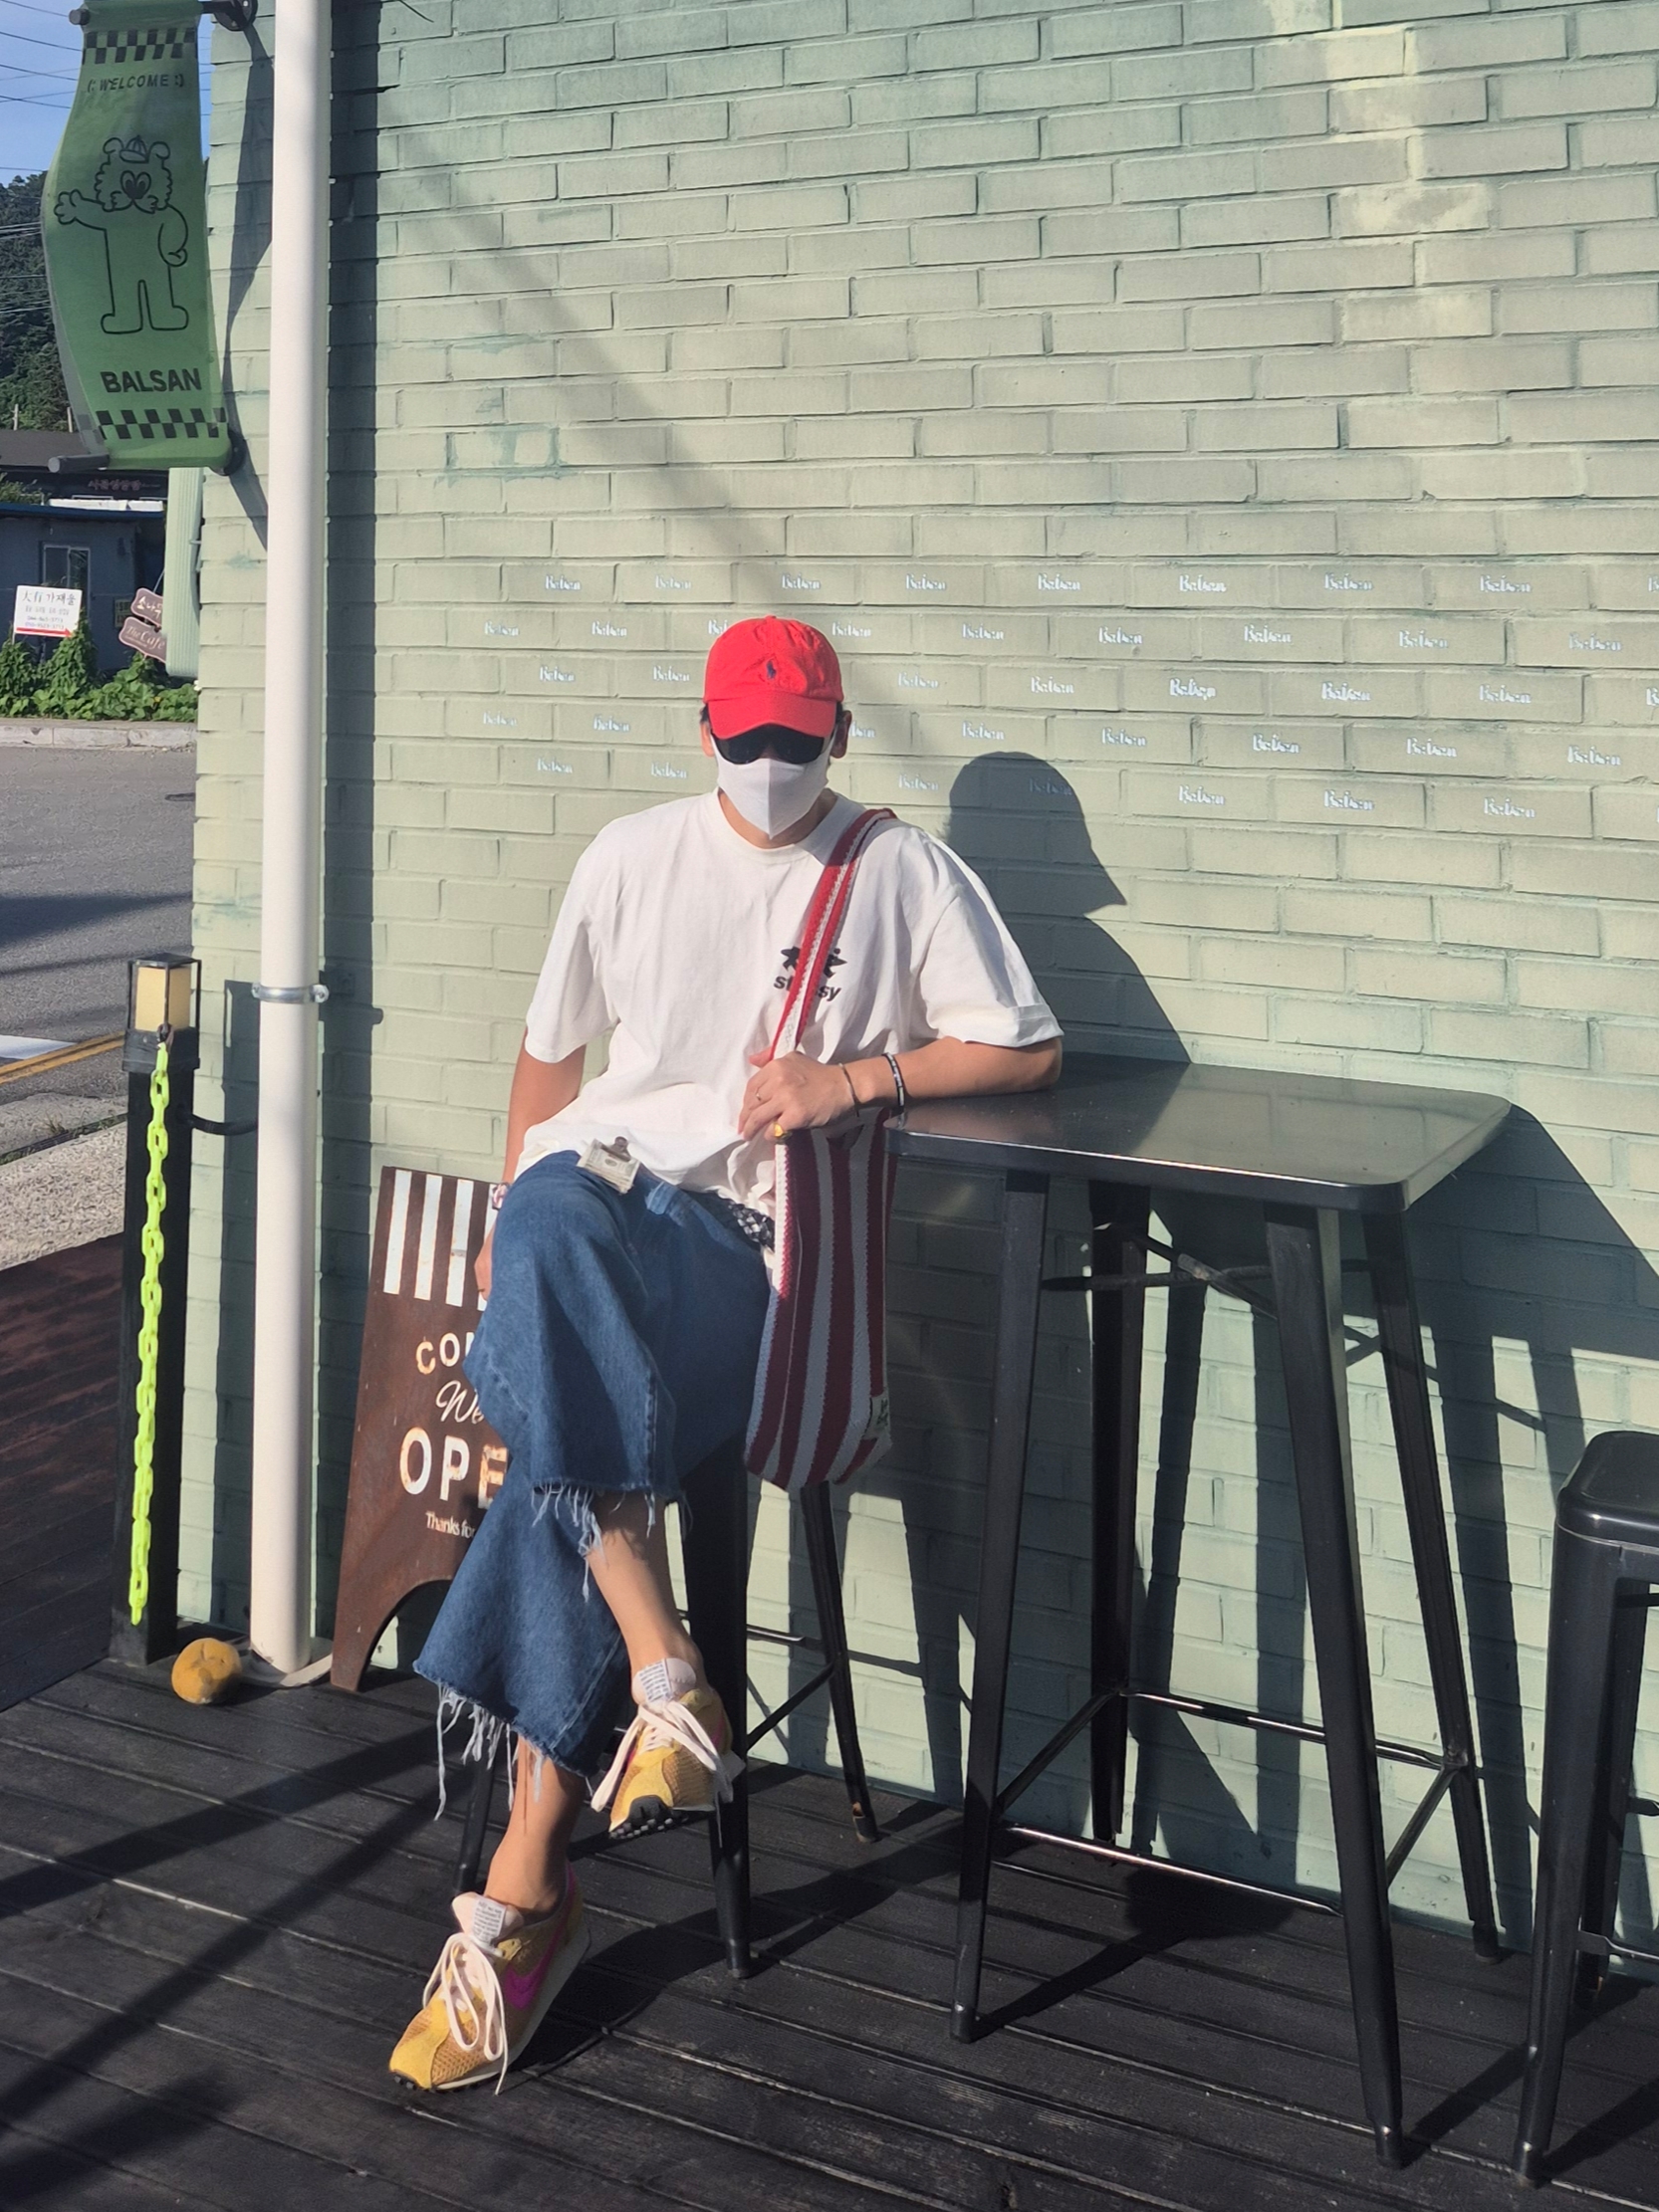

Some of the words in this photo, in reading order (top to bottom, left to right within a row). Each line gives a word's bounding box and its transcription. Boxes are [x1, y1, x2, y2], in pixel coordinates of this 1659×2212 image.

[100, 74, 169, 92] WELCOME
[100, 367, 202, 394] BALSAN
[399, 1427, 509, 1510] OPE
[425, 1510, 460, 1537] Thanks
